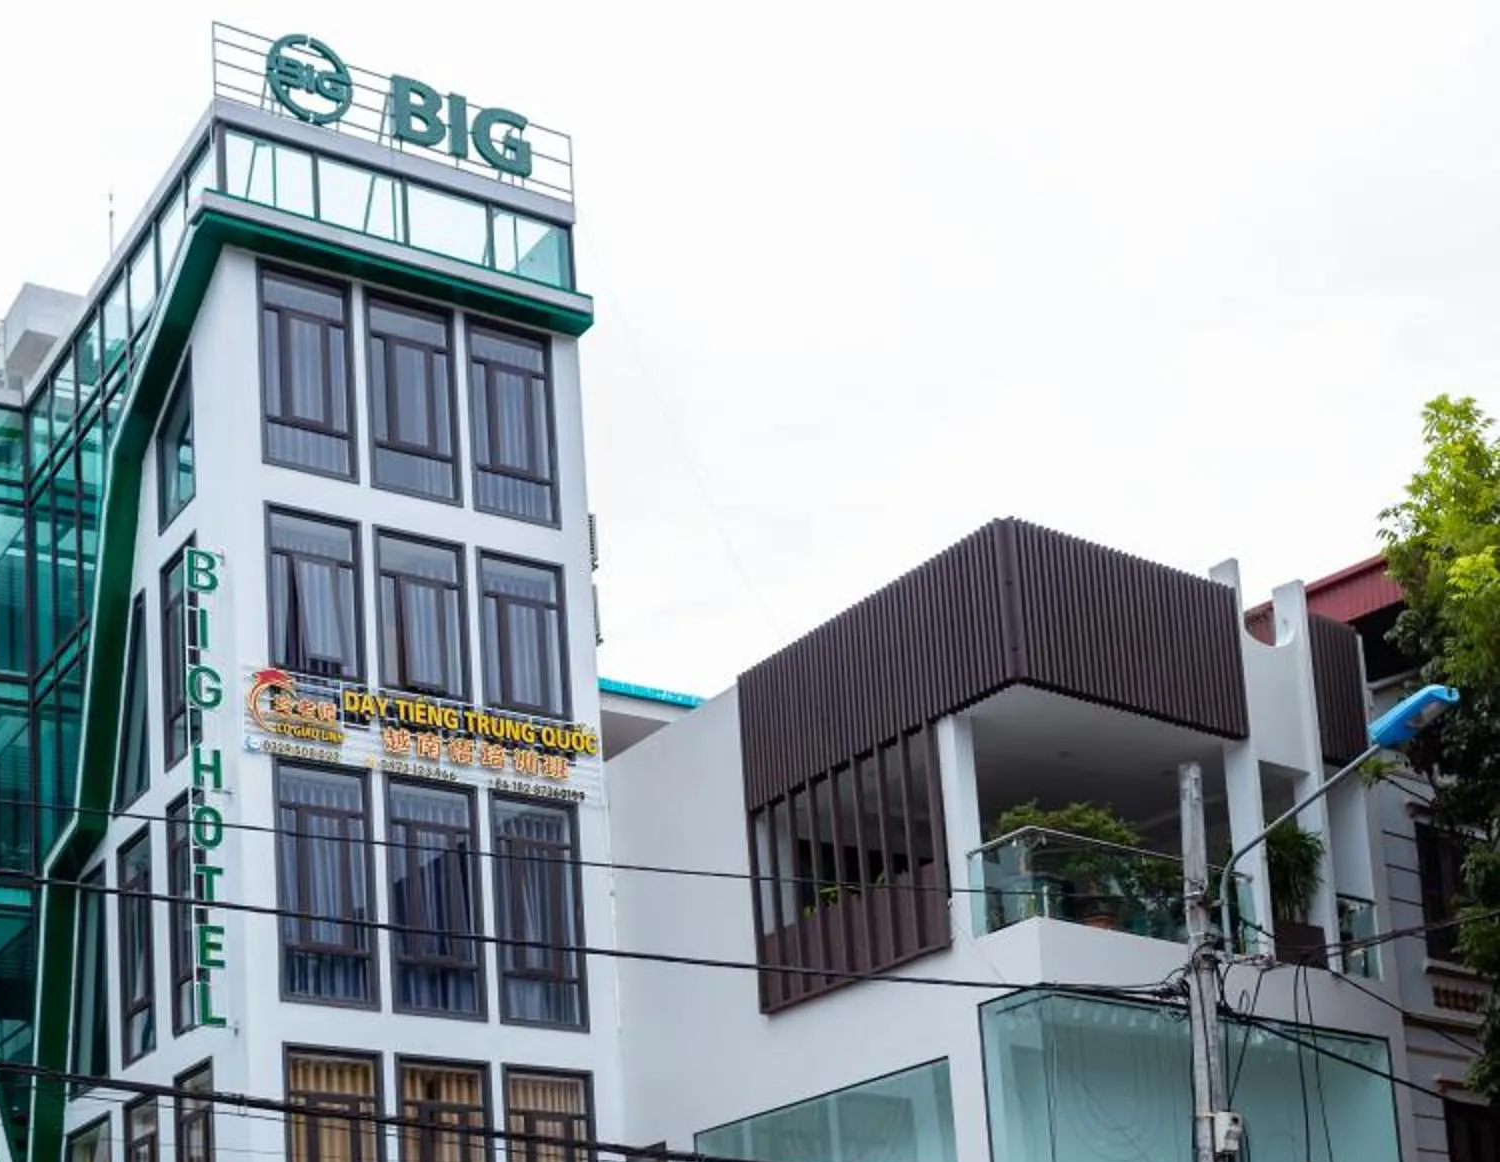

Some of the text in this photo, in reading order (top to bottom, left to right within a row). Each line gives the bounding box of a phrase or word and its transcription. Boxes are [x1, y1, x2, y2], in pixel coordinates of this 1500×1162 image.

[389, 74, 532, 178] BIG
[186, 548, 223, 711] BIG
[463, 710, 535, 744] TRUNG
[192, 749, 227, 1026] HOTEL
